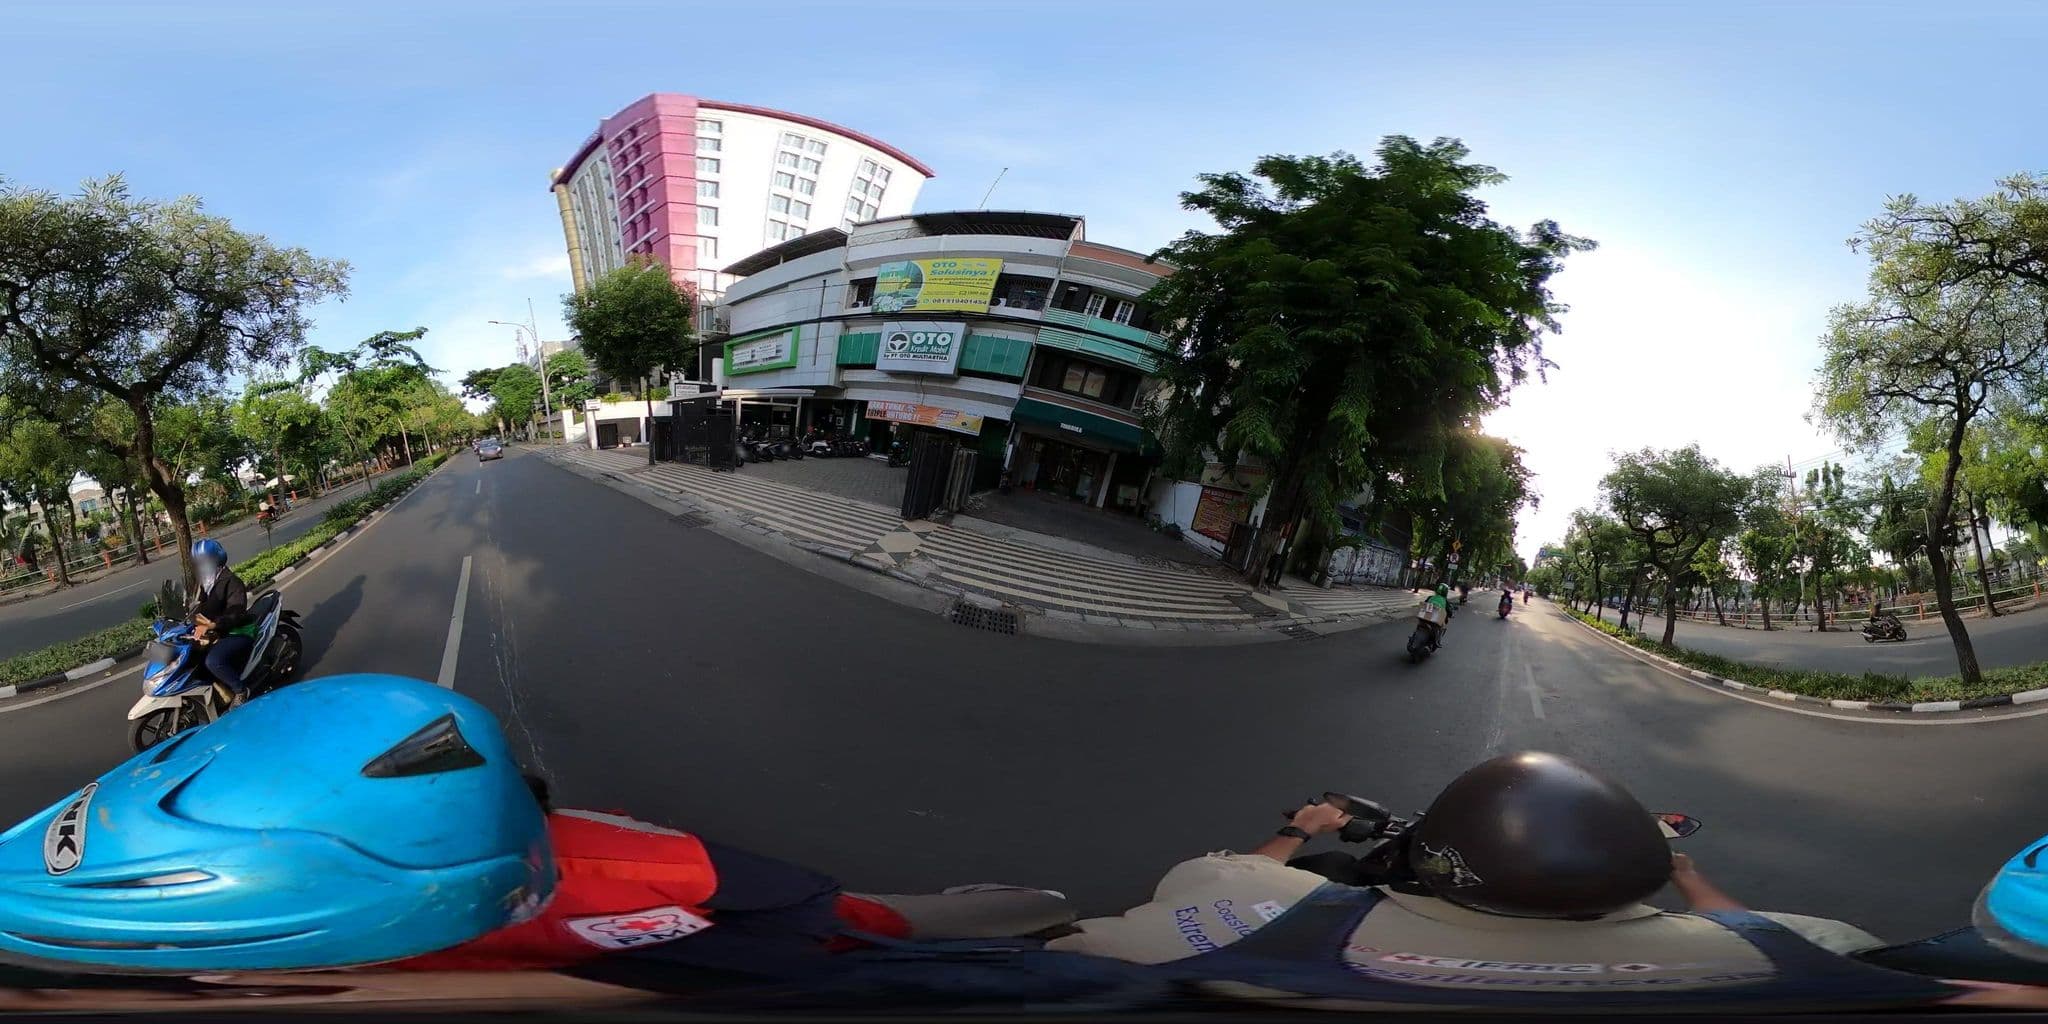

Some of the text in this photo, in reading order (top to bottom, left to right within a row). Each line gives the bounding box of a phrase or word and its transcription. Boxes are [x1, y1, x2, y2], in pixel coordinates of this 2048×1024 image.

[929, 268, 987, 277] Solusinya
[912, 332, 952, 346] OTO
[930, 346, 948, 354] Mobil
